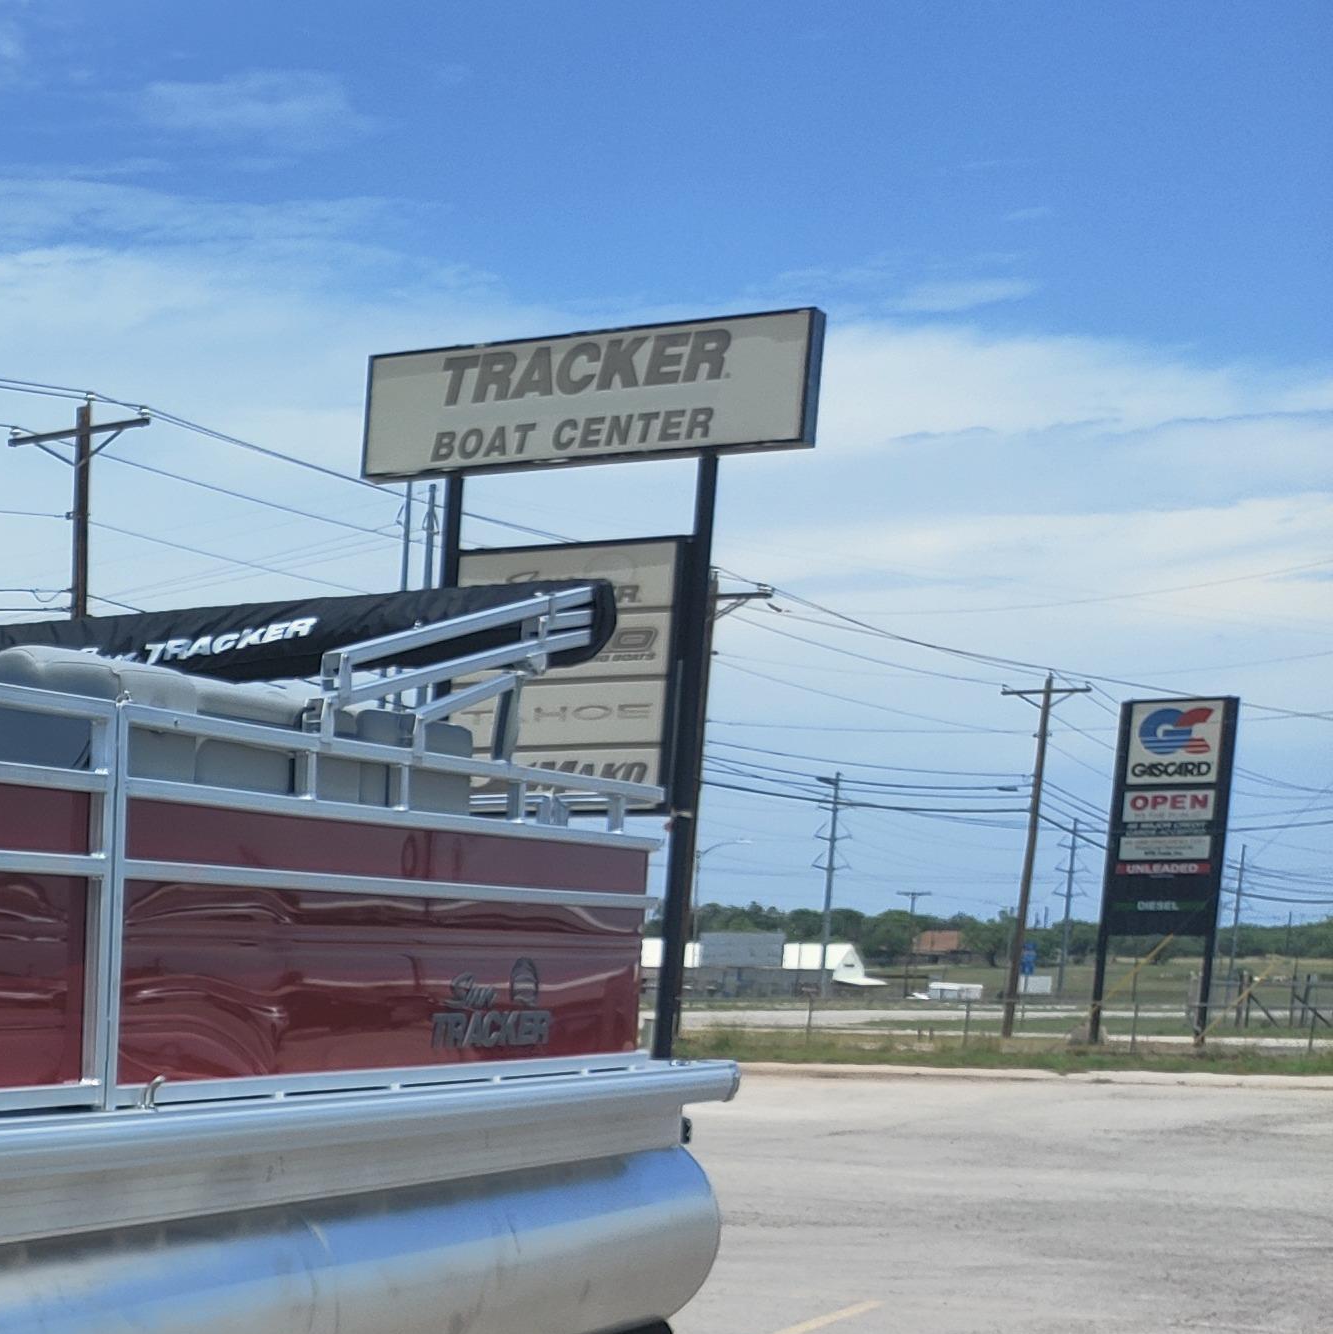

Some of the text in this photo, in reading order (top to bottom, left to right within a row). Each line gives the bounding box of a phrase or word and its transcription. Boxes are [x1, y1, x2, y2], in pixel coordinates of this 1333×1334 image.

[444, 328, 733, 407] TRACKER
[430, 407, 715, 463] BOAT CENTER
[144, 615, 320, 665] TRACKER
[461, 703, 653, 725] THOE
[1132, 761, 1211, 777] GASCARD
[1130, 794, 1208, 811] OPEN
[1126, 862, 1199, 874] UNLEADED
[1137, 900, 1179, 911] DIESEL
[432, 1009, 554, 1050] TRACKER
